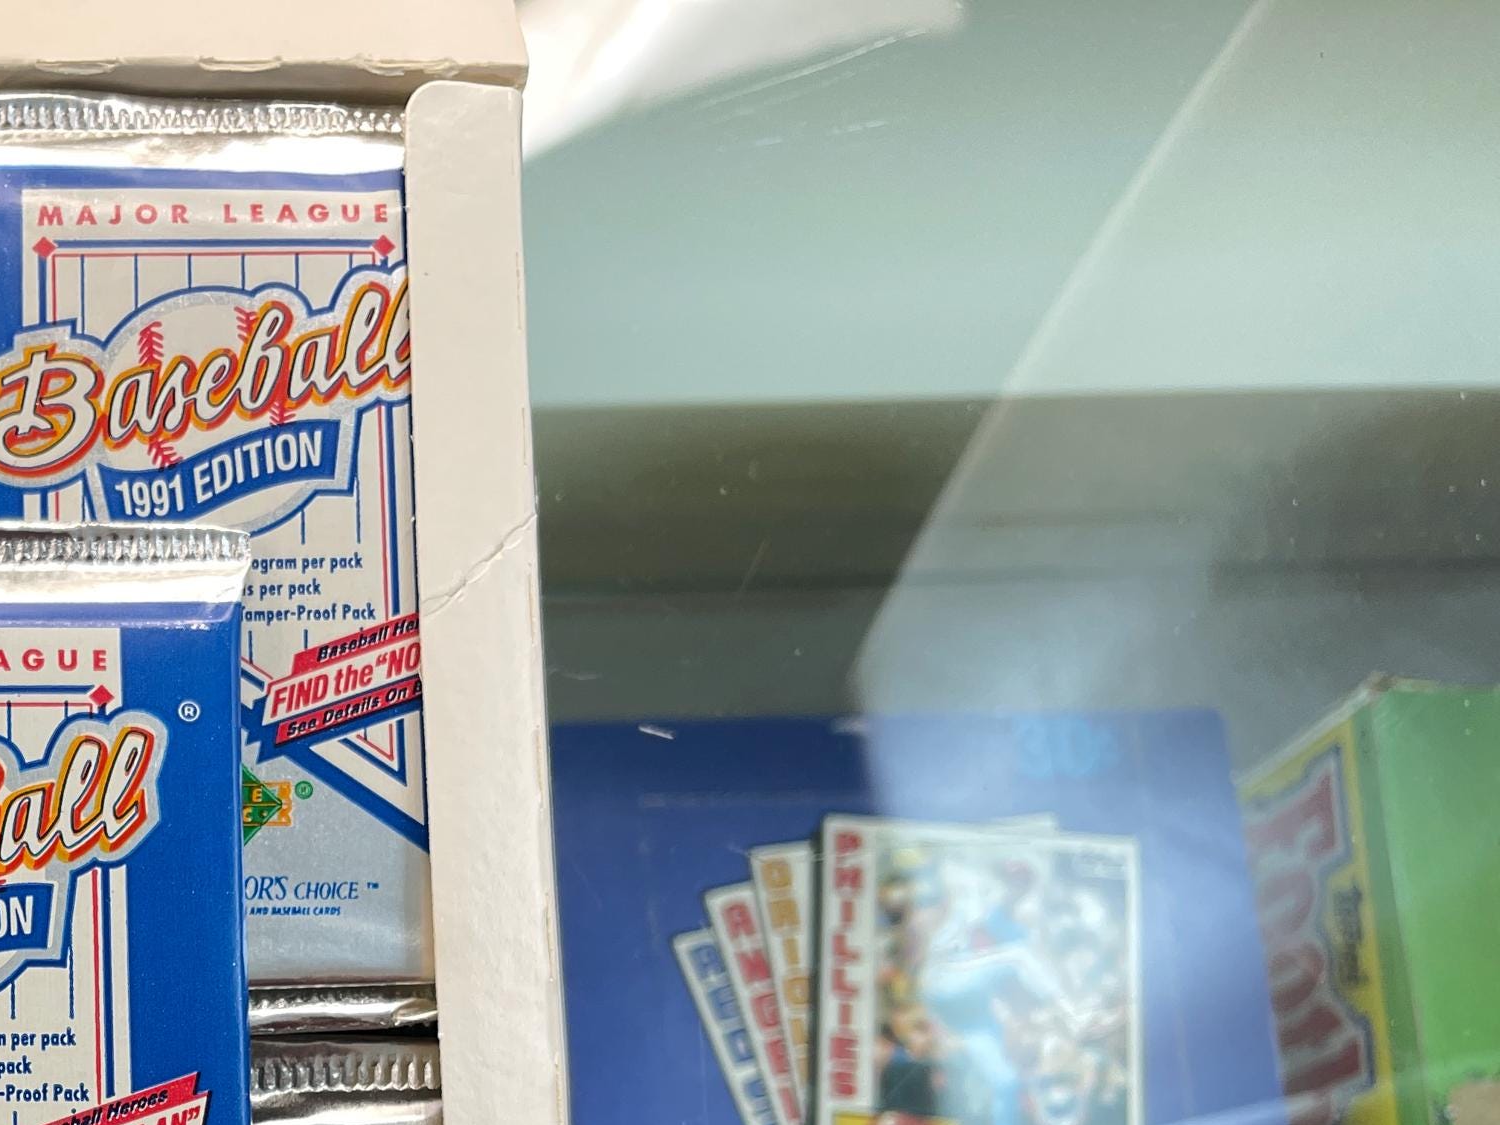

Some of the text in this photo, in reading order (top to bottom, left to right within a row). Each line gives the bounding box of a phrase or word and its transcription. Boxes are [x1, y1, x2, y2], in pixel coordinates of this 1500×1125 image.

[37, 202, 389, 226] MAJOR LEAGUE
[115, 431, 323, 518] 1991 EDITION
[302, 552, 363, 574] per pack
[260, 581, 286, 598] per
[289, 578, 321, 597] pack
[342, 602, 376, 620] Pack
[316, 625, 388, 662] Baseball
[270, 678, 329, 718] FIND
[334, 663, 373, 696] the
[286, 719, 317, 736] See
[322, 695, 380, 724] Details
[386, 689, 408, 704] On
[294, 881, 359, 900] CHOICE
[271, 906, 341, 916] BASEBALL CARDS
[830, 831, 863, 1098] PHILLIES
[11, 1034, 37, 1053] per
[41, 1029, 77, 1050] pack
[53, 1084, 89, 1103] Pack
[107, 1088, 169, 1120] Heroes
